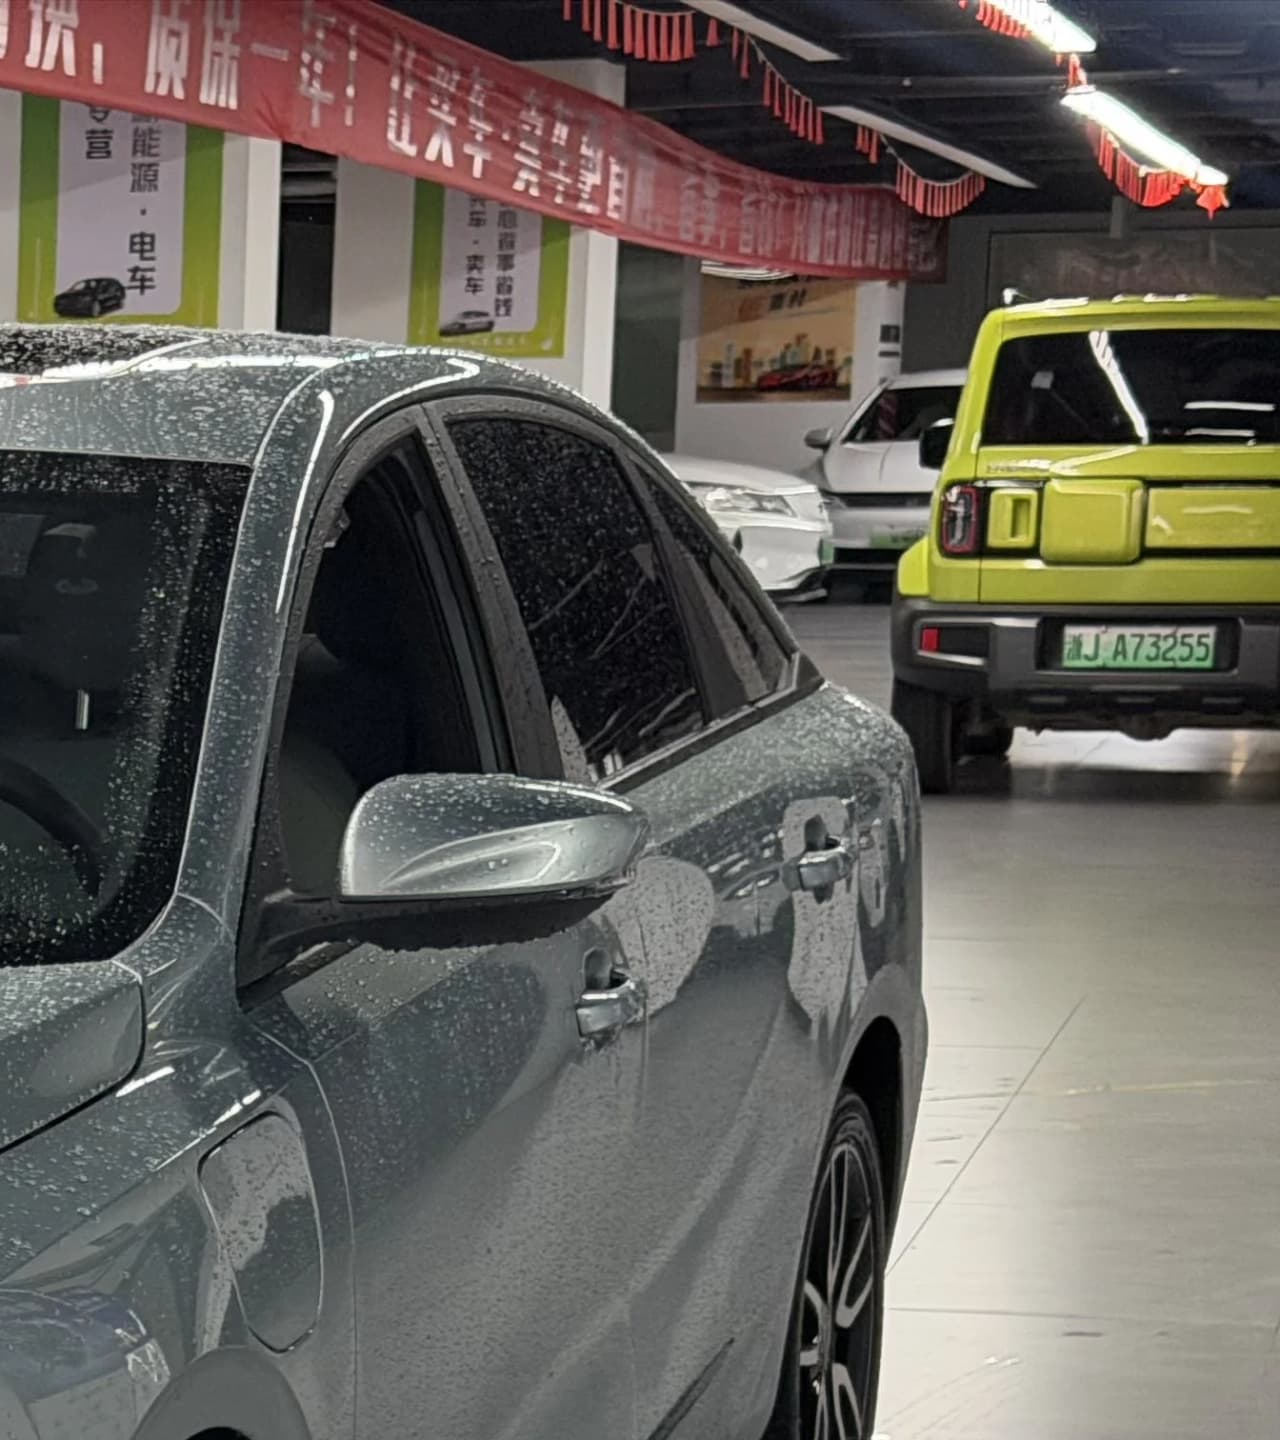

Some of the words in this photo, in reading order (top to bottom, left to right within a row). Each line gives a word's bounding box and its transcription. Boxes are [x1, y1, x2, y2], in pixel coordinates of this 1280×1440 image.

[125, 115, 163, 295] 能源·电车
[1112, 633, 1210, 662] A73255
